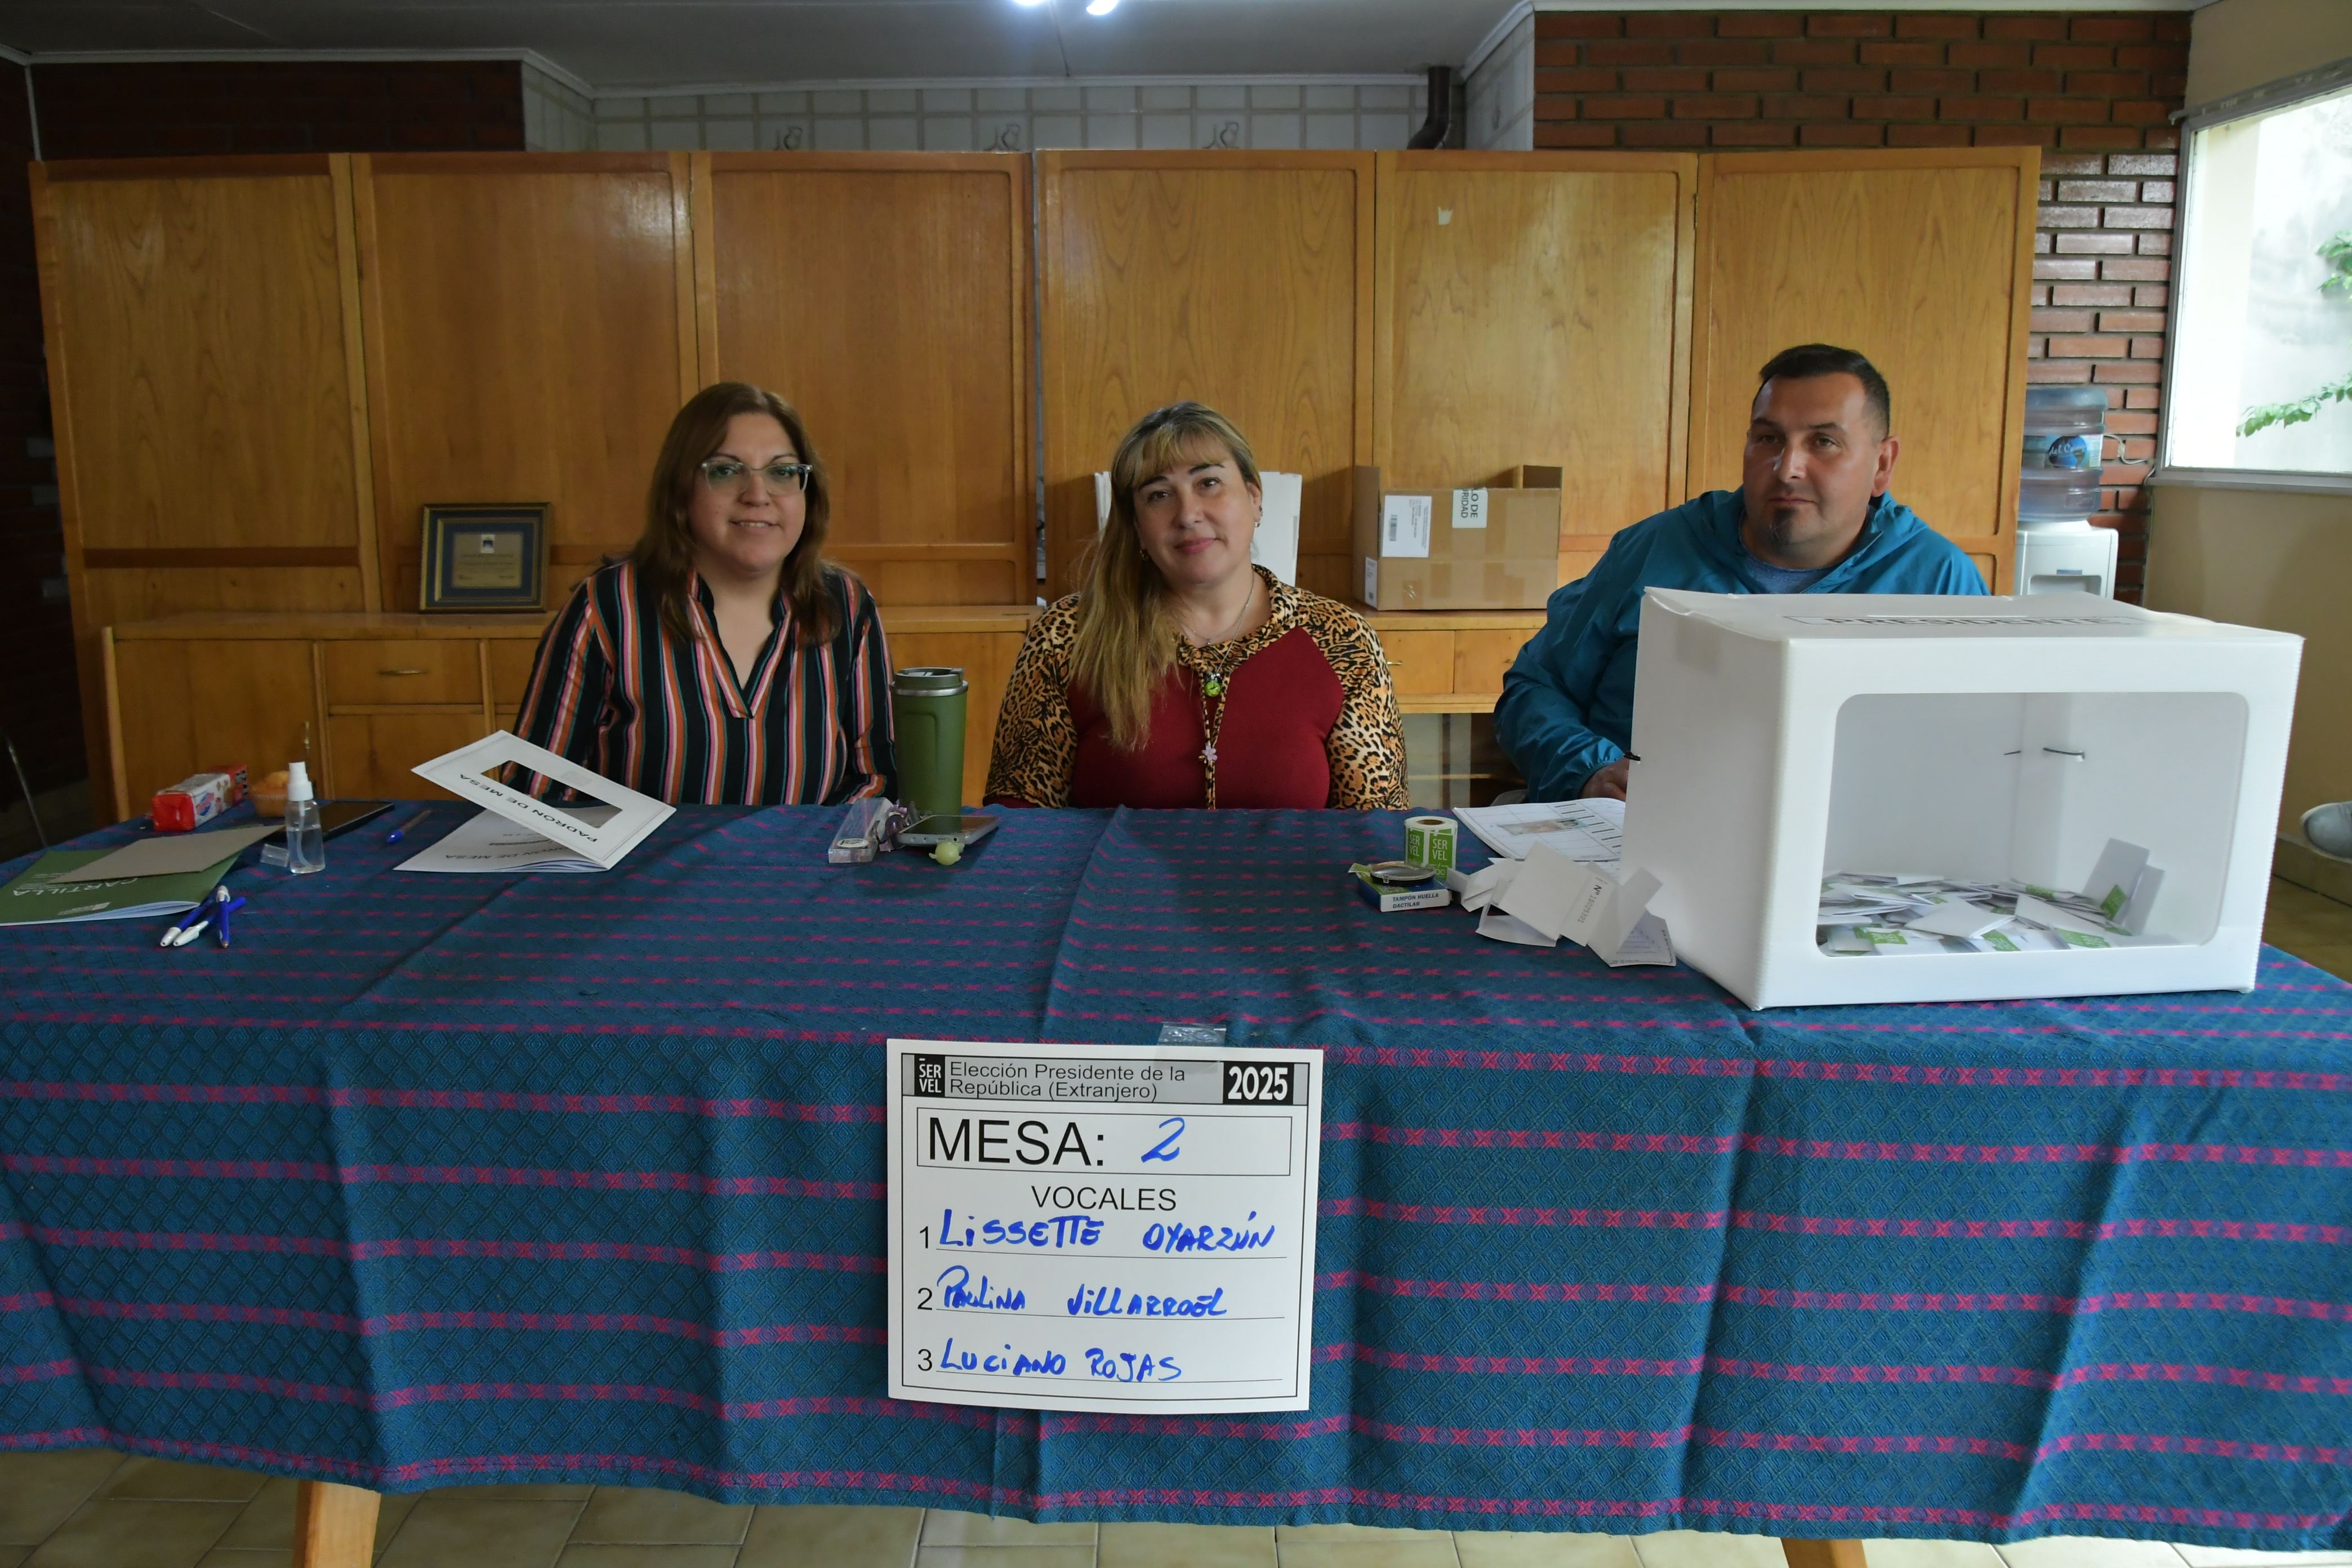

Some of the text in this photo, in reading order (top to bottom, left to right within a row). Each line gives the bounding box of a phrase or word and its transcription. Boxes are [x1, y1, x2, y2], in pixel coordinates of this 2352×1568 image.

[1471, 505, 1478, 518] DE
[460, 774, 598, 842] PADRÓN DE MESA
[1410, 834, 1420, 845] SER
[1433, 839, 1447, 850] SER
[1410, 845, 1419, 856] VEL
[1432, 849, 1447, 861] VEL
[13, 877, 138, 896] CARTILLA
[919, 1063, 941, 1079] SER
[950, 1061, 1185, 1082] Elección Presidente de la
[919, 1078, 942, 1093] VEL
[950, 1081, 1158, 1102] República (Extranjero)
[1228, 1066, 1288, 1101] 2025
[928, 1117, 1186, 1166] MESA: 2
[1031, 1186, 1177, 1211] VOCALES
[919, 1226, 930, 1249] 1
[917, 1288, 933, 1311] 2
[917, 1348, 933, 1372] 3
[1085, 1347, 1183, 1383] ROJAS
